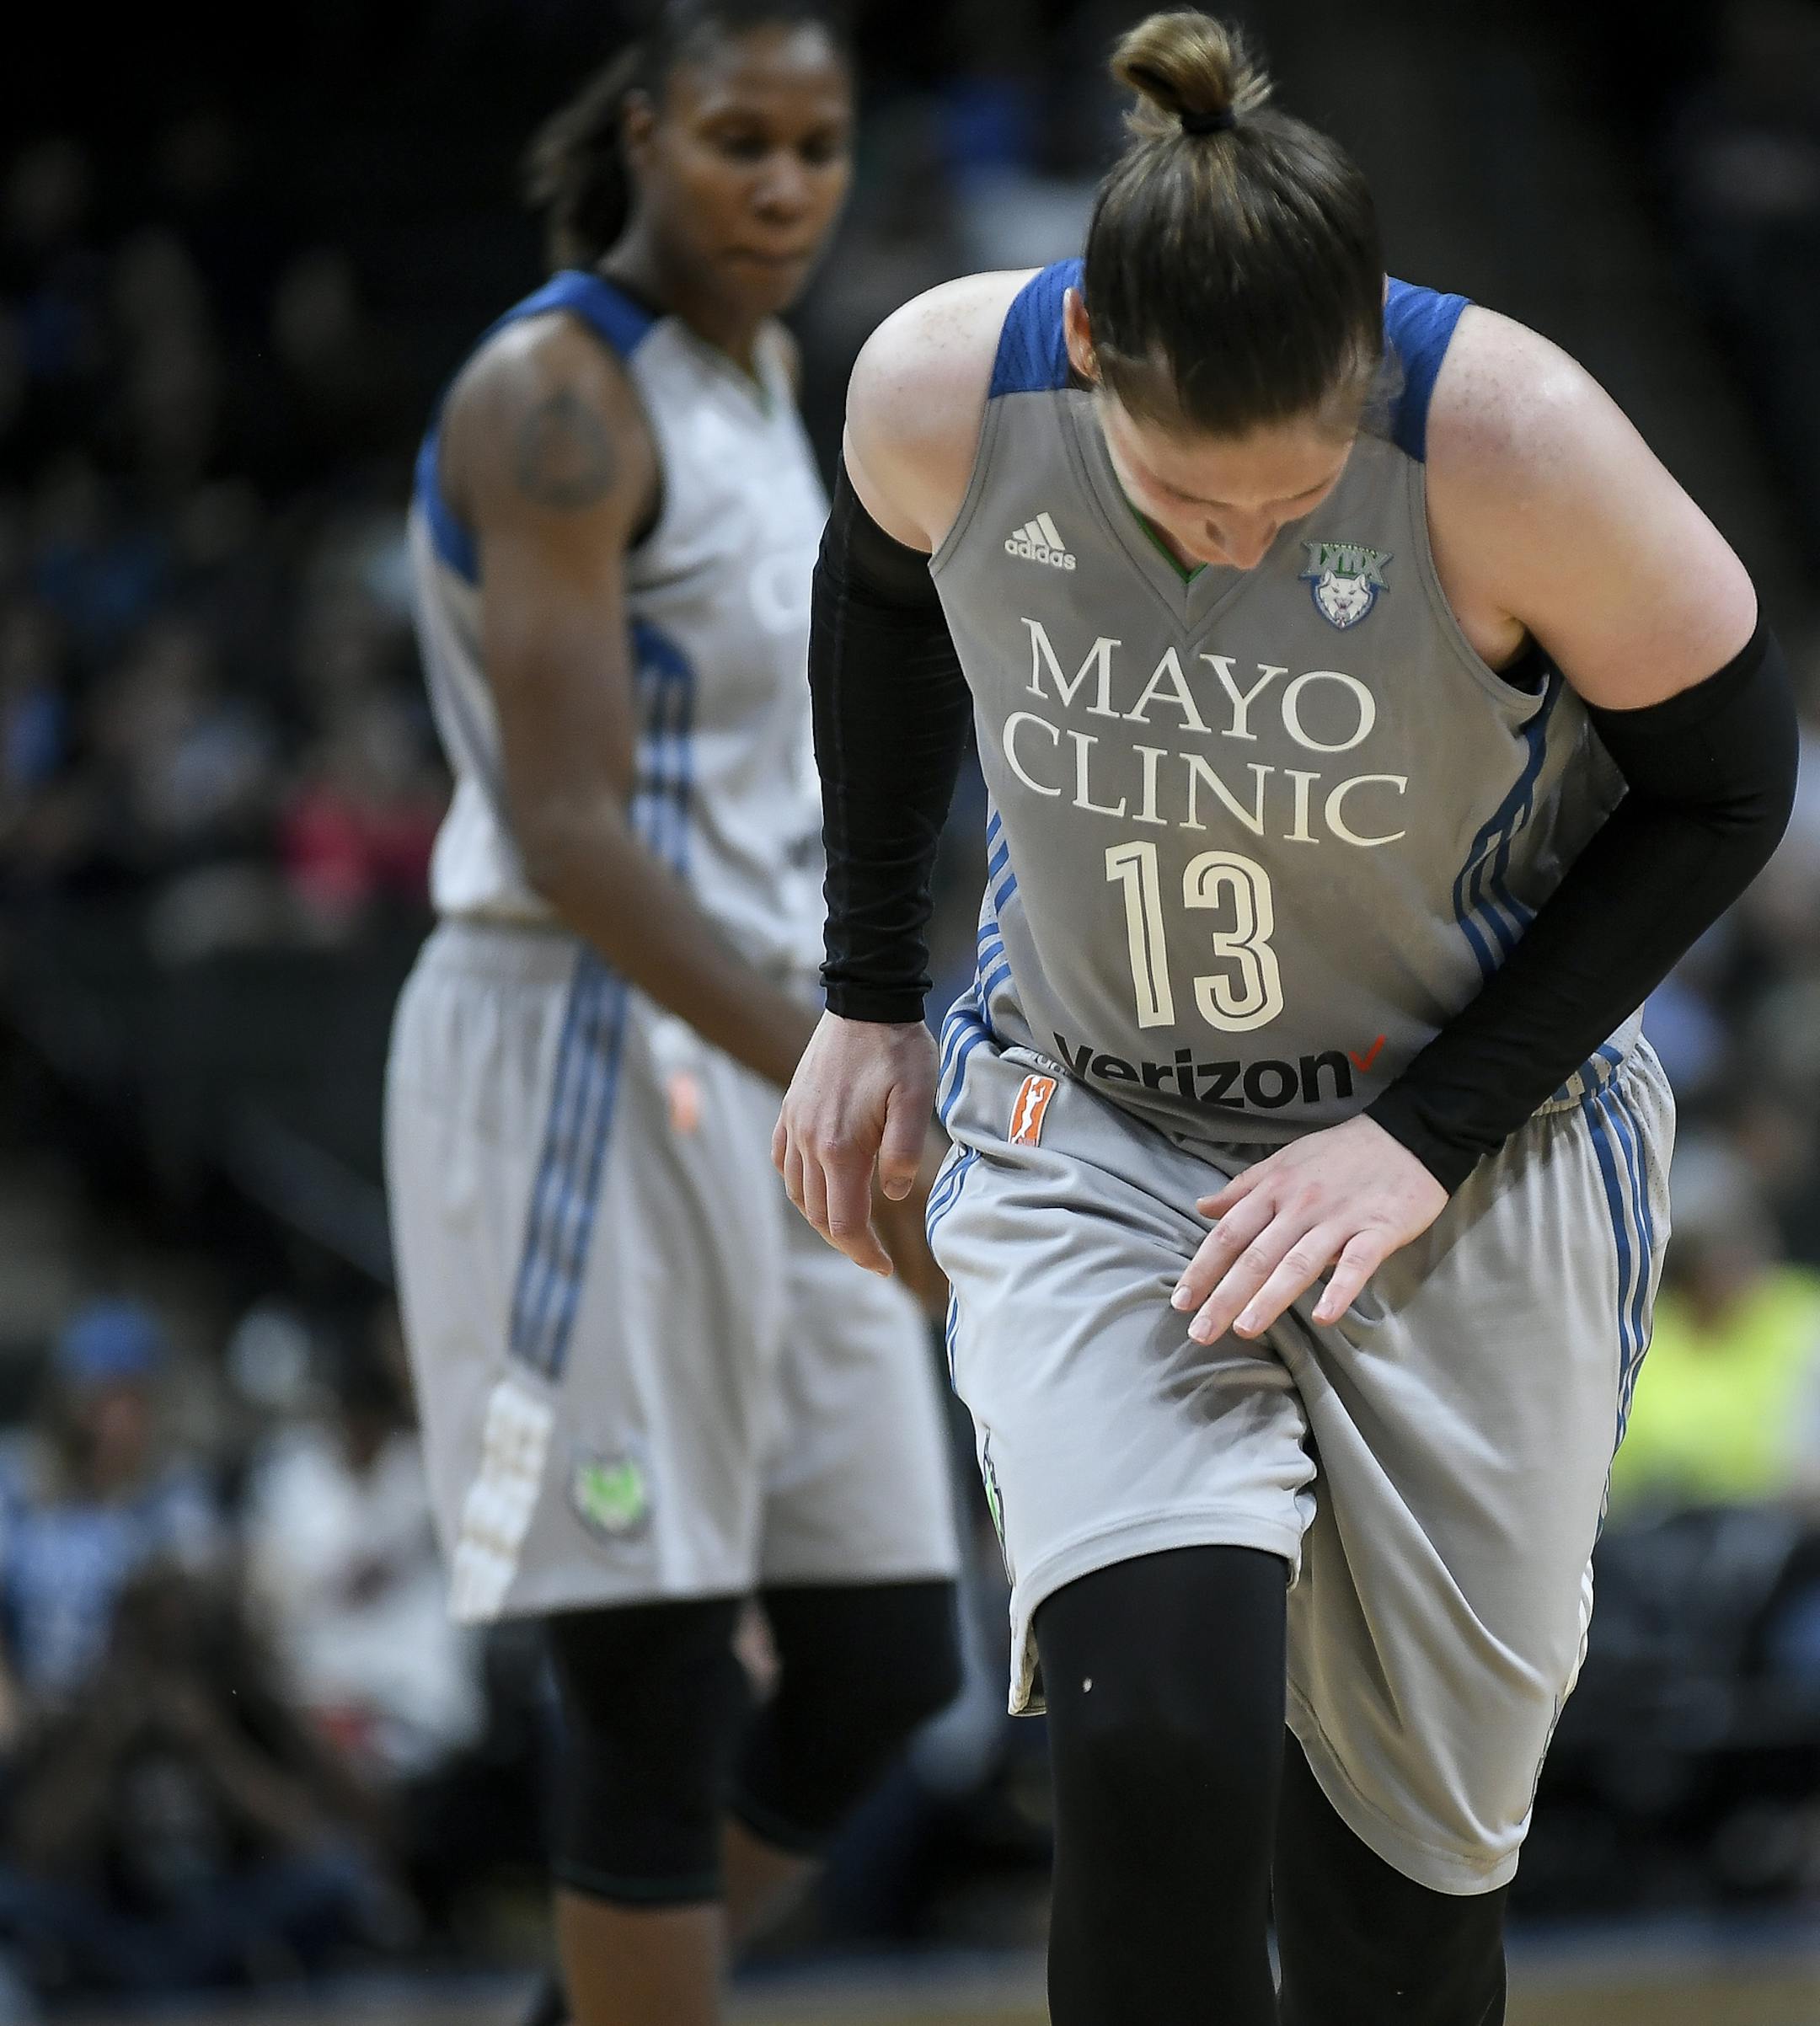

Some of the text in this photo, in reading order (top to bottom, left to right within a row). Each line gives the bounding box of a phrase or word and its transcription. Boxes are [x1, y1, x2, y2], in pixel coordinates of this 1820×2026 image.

[1004, 538, 1077, 570] adidas
[1299, 541, 1394, 591] LYNX
[1020, 617, 1376, 753] MAYO
[1003, 711, 1409, 847] CLINIC
[1105, 841, 1285, 1032] 13
[1053, 1031, 1353, 1109] verizon
